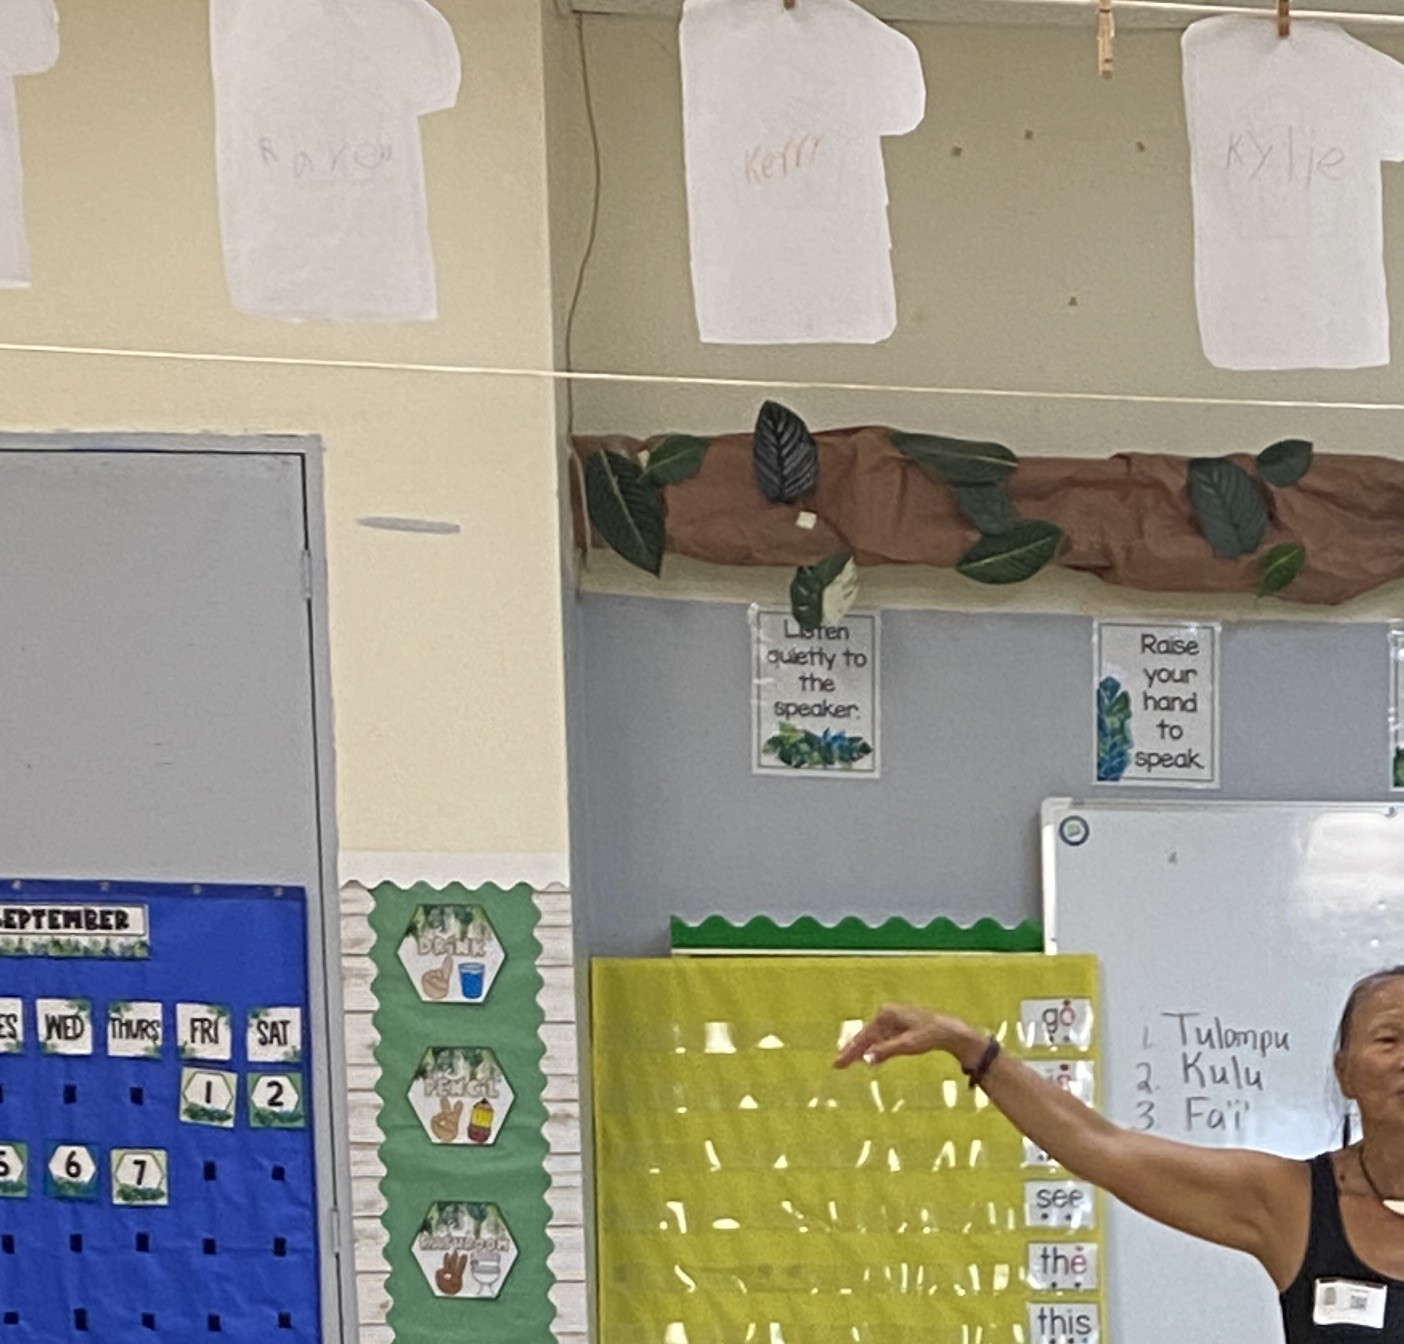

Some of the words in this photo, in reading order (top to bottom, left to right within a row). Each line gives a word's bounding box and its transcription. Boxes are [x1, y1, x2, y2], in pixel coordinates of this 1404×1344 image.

[1141, 634, 1200, 656] Raise
[846, 650, 868, 667] to
[798, 673, 835, 691] the
[1143, 667, 1198, 688] your
[774, 699, 861, 720] speaker.
[1143, 690, 1197, 713] hand
[1156, 719, 1183, 740] to
[0, 908, 129, 930] EPTEMBER
[417, 936, 486, 957] DRINK
[44, 1014, 84, 1040] WED
[110, 1017, 160, 1043] THURS
[190, 1018, 219, 1037] FRI
[1042, 1007, 1075, 1034] go
[257, 1021, 290, 1045] SAT
[1182, 1051, 1263, 1091] Kulu
[205, 1081, 212, 1103] 1
[266, 1081, 284, 1106] 2
[423, 1079, 500, 1098] PENCIL
[65, 1151, 81, 1178] 6
[133, 1160, 147, 1185] 7
[1036, 1188, 1084, 1208] see
[1040, 1247, 1087, 1275] the
[1037, 1307, 1092, 1335] this
